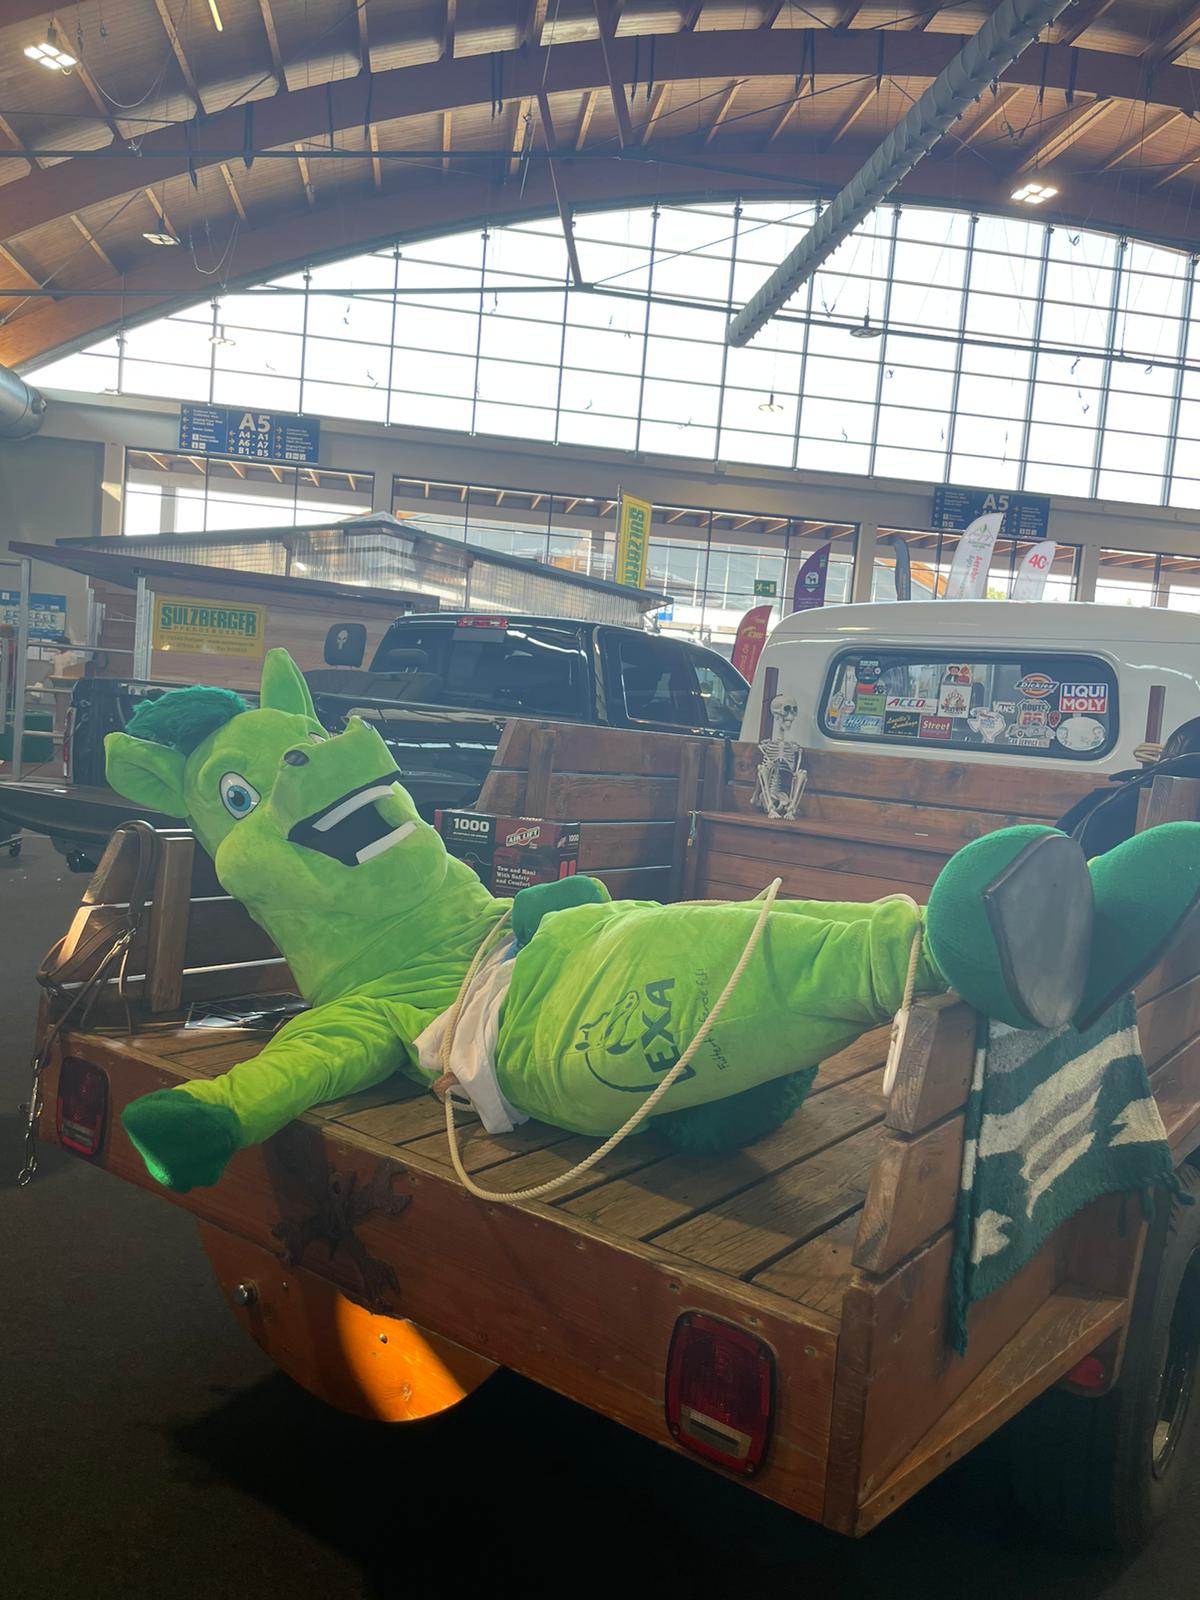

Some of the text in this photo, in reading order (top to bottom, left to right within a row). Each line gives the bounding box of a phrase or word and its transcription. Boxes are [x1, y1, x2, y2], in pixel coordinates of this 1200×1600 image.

[239, 413, 271, 433] A5
[258, 433, 269, 441] A1
[257, 449, 269, 457] B5
[983, 493, 1009, 511] A5
[161, 606, 256, 635] SULZBERGER
[1021, 682, 1053, 690] Dickies
[1064, 685, 1104, 698] LIQUI
[888, 698, 925, 707] ACCO
[993, 701, 1015, 712] VANS
[1022, 703, 1049, 711] ROUTE
[1062, 698, 1105, 711] MOLY
[923, 720, 949, 731] Street
[454, 818, 489, 832] 1000
[508, 828, 538, 843] AIR LIFT
[641, 978, 697, 1085] LEXA
